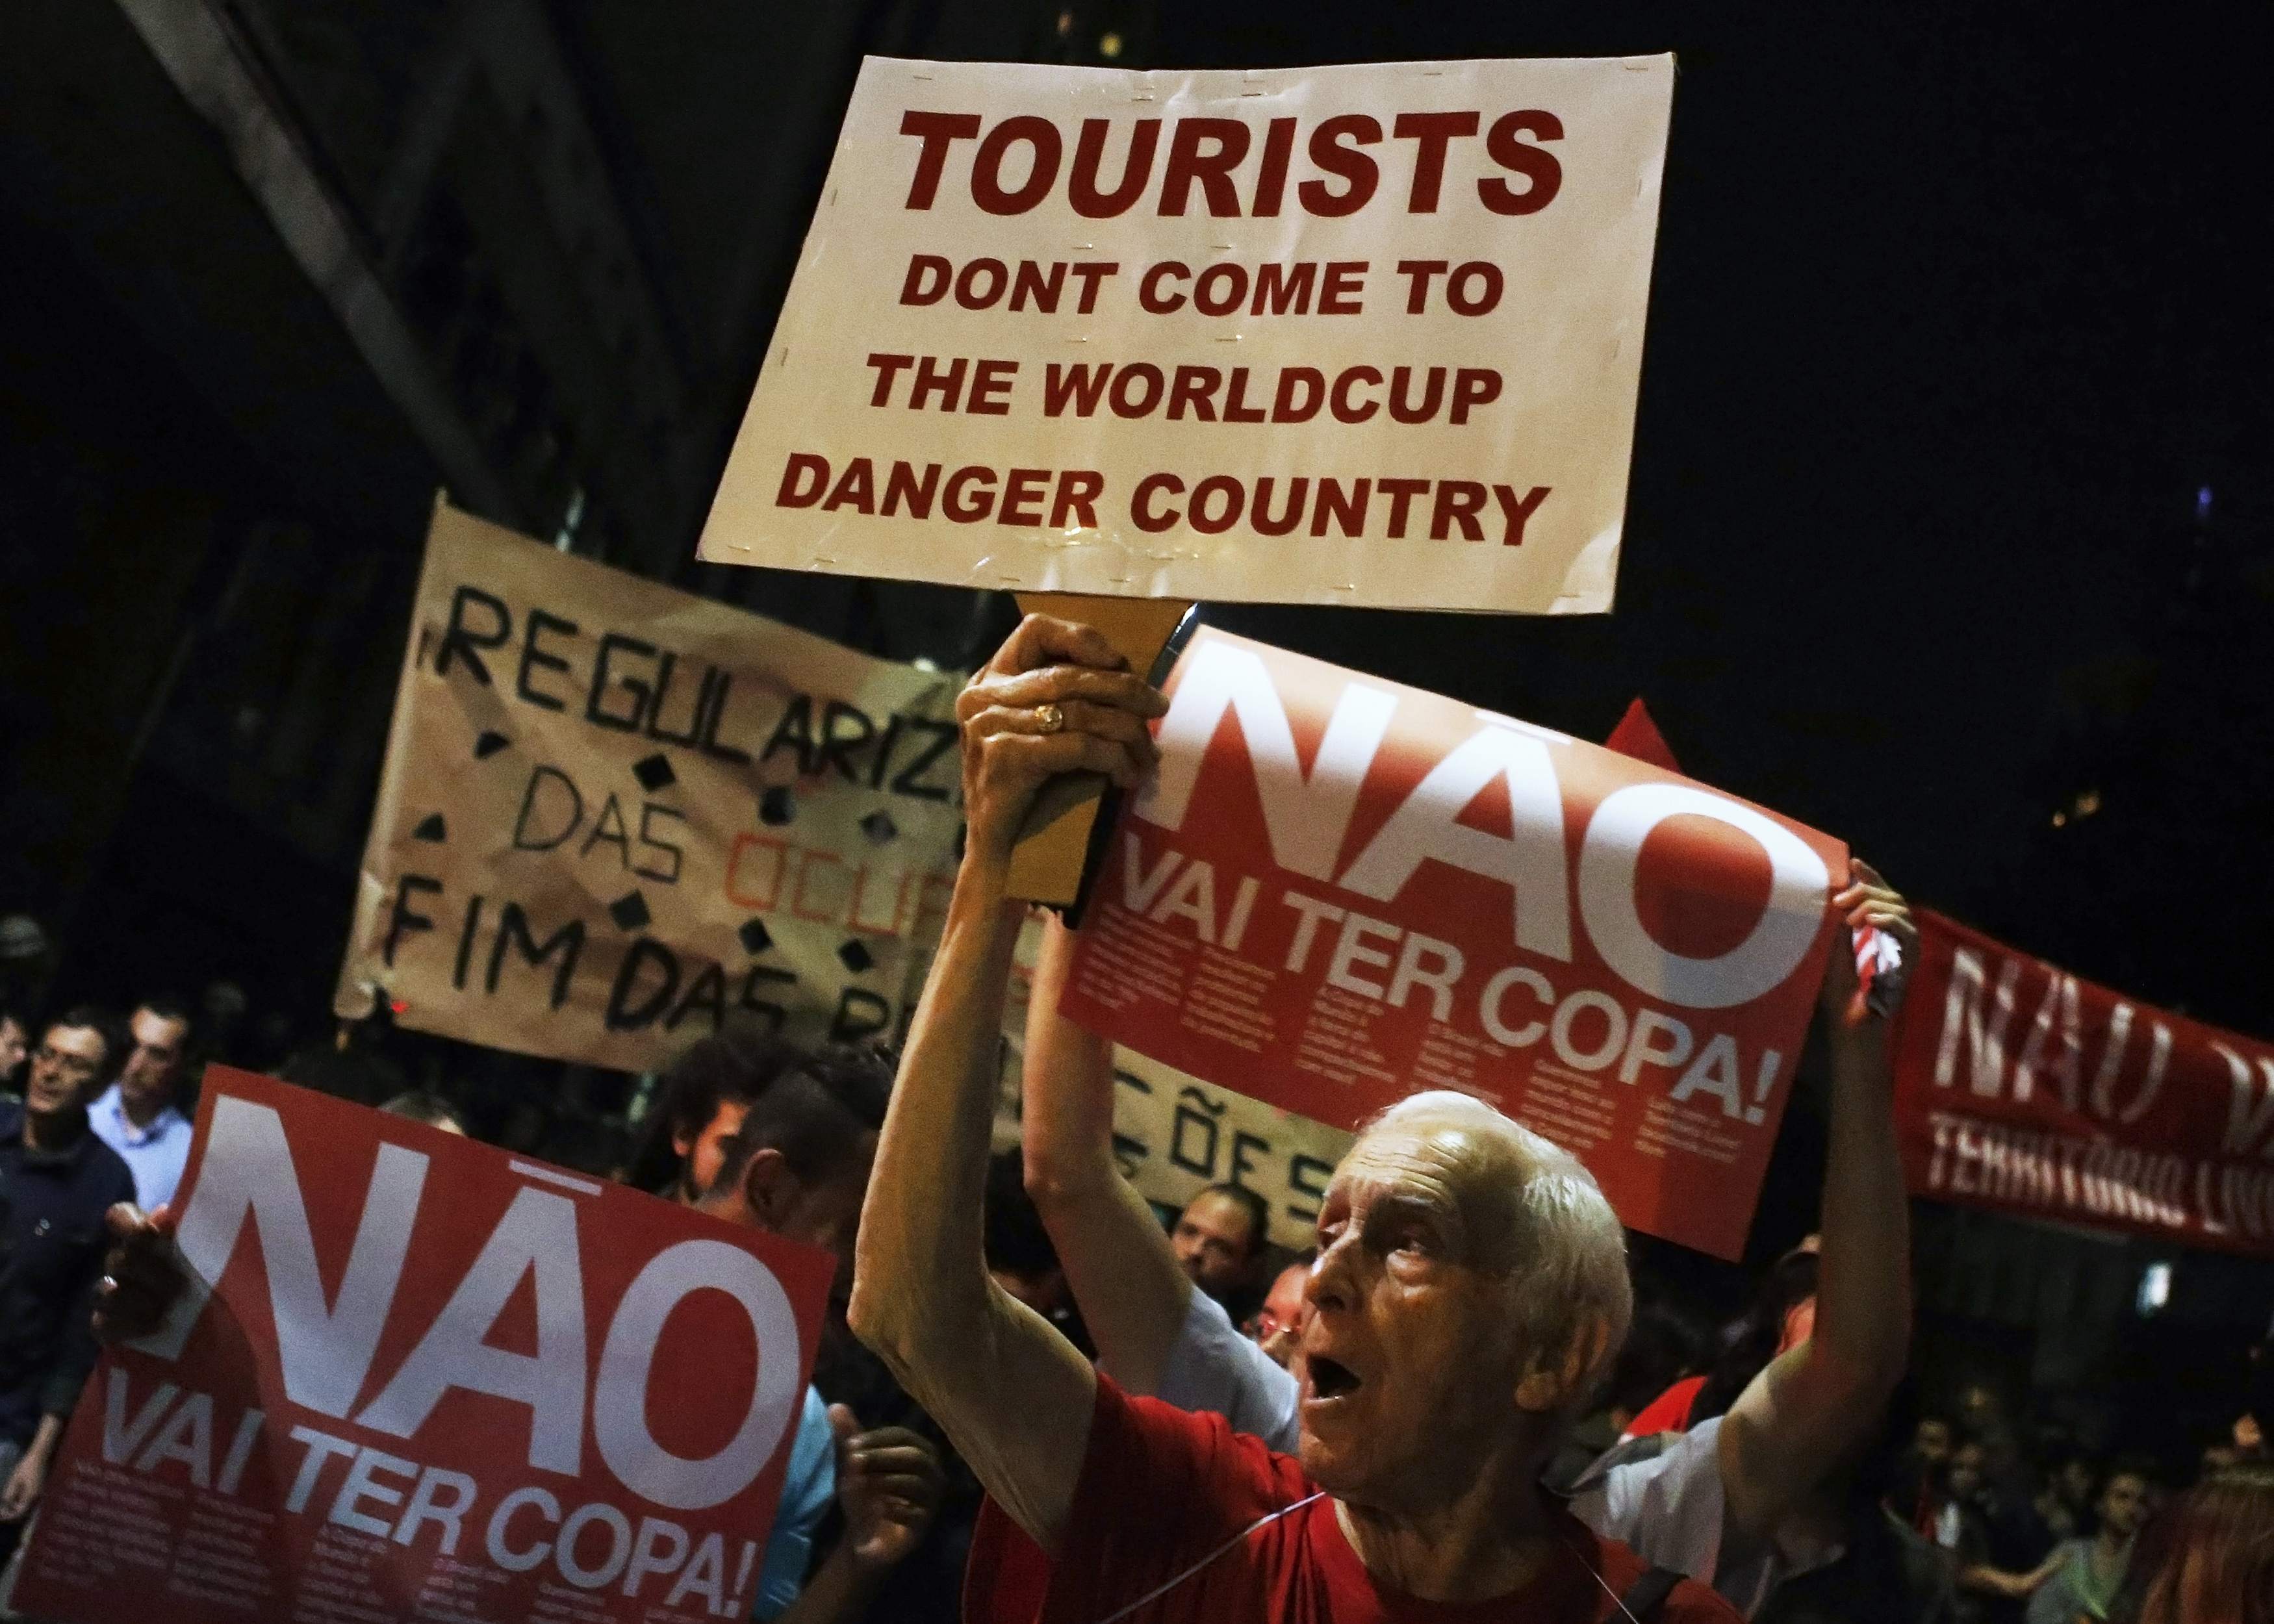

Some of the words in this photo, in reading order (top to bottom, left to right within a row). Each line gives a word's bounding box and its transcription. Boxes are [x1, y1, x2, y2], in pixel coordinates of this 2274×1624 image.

[899, 110, 1565, 218] TOURISTS
[899, 254, 1118, 312] DONT
[1138, 260, 1367, 317] COME
[1396, 260, 1505, 317] TO
[865, 353, 1019, 416] THE
[1043, 361, 1503, 425] WORLDCUP
[776, 452, 1105, 530] DANGER
[1130, 472, 1552, 546] COUNTRY
[433, 585, 960, 804] REGULARIZ
[512, 765, 685, 883] DAS
[1134, 639, 1829, 1008] NÃO
[383, 874, 586, 1012] FIM
[604, 935, 798, 1032] DAS
[1118, 835, 1259, 950] VAI
[1283, 891, 1465, 1021] TER
[1480, 967, 1782, 1126] COPA!
[122, 1094, 800, 1509] NÃO
[102, 1367, 266, 1495] VAI
[285, 1427, 476, 1555] TER
[485, 1487, 757, 1620] COPA!
